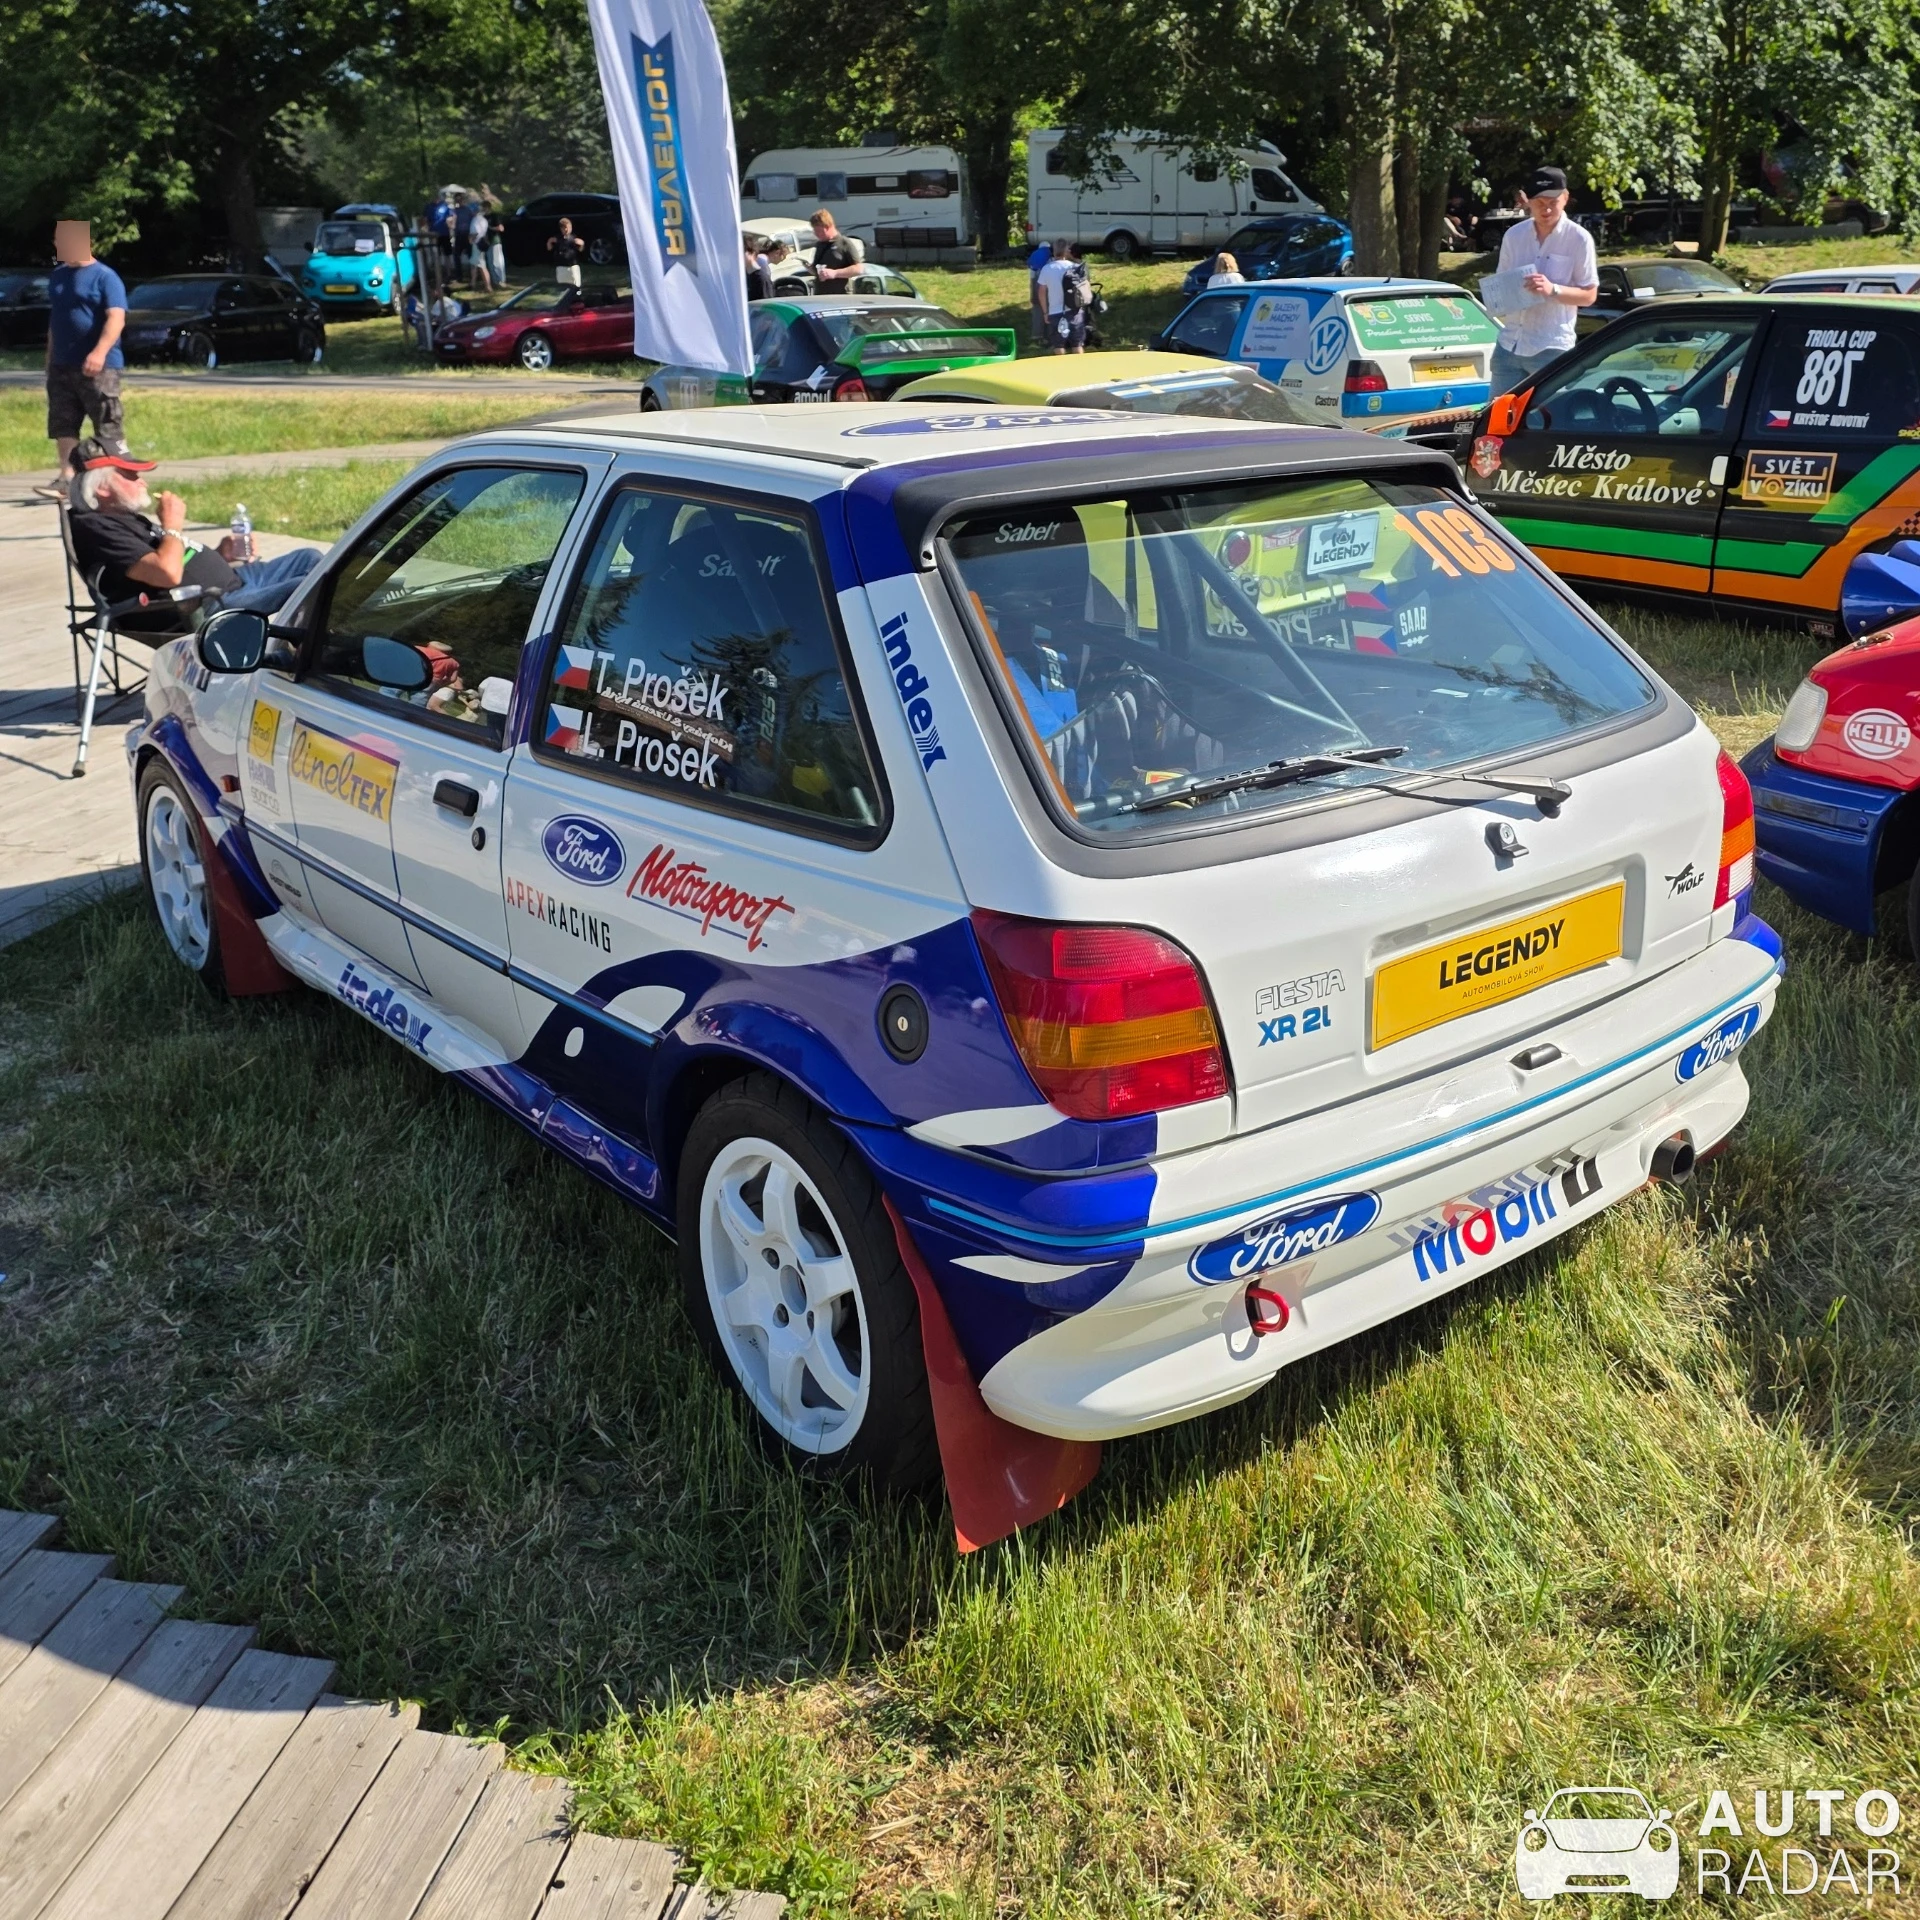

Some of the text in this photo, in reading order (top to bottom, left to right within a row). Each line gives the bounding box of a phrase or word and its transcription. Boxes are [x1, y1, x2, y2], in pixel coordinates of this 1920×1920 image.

[1404, 313, 1434, 323] SERVIS
[1804, 329, 1877, 349] TRIOLA CUP
[1315, 395, 1339, 407] Castrol
[923, 413, 1132, 429] Ford
[1547, 444, 1632, 471] Město
[1764, 457, 1816, 476] SVĚT
[1492, 468, 1708, 506] Městec Králové
[995, 521, 1060, 544] Sabelt
[1392, 508, 1516, 577] 103
[1313, 541, 1370, 565] LEGENDY
[1399, 606, 1427, 636] SAAB
[623, 657, 729, 721] Prošek
[880, 611, 947, 773] index
[583, 711, 605, 758] L.
[614, 719, 720, 788] Prošek
[1849, 723, 1911, 749] HELLA
[555, 824, 610, 876] Ford
[626, 843, 796, 953] Motorsport
[1677, 872, 1705, 895] WOLF
[1439, 919, 1566, 989] LEGENDY
[1255, 969, 1346, 1015] FIESTA
[1461, 963, 1545, 999] AUTOMOBILOVÁ SHOW
[337, 962, 433, 1056] index
[1257, 1014, 1297, 1048] XR
[1693, 1011, 1750, 1069] Ford
[1229, 1204, 1349, 1277] Ford
[1412, 1178, 1557, 1282] Mobil
